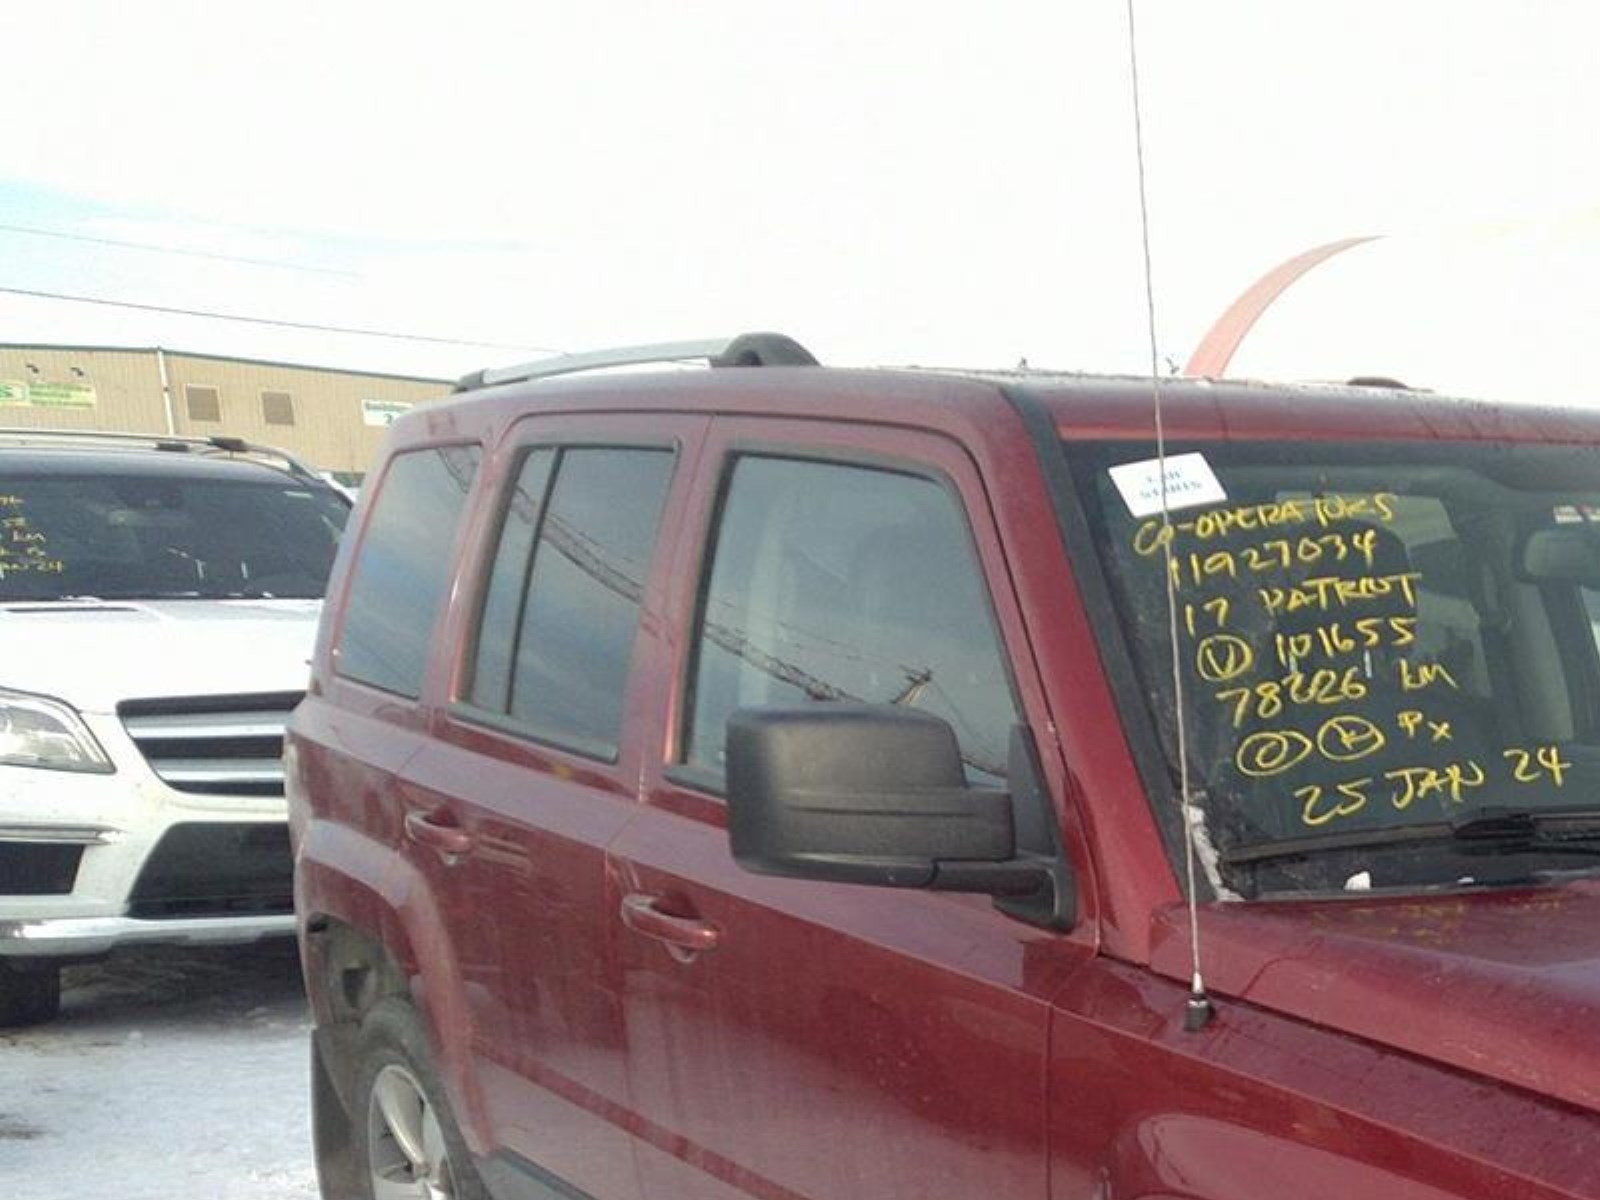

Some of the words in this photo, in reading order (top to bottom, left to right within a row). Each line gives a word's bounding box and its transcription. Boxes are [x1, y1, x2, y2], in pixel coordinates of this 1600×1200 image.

[1170, 529, 1376, 590] 11927034
[1185, 597, 1228, 637] 17
[1276, 617, 1417, 667] 101655
[1294, 778, 1373, 825] 25
[1385, 760, 1484, 808] JAN
[1503, 746, 1571, 786] 24
